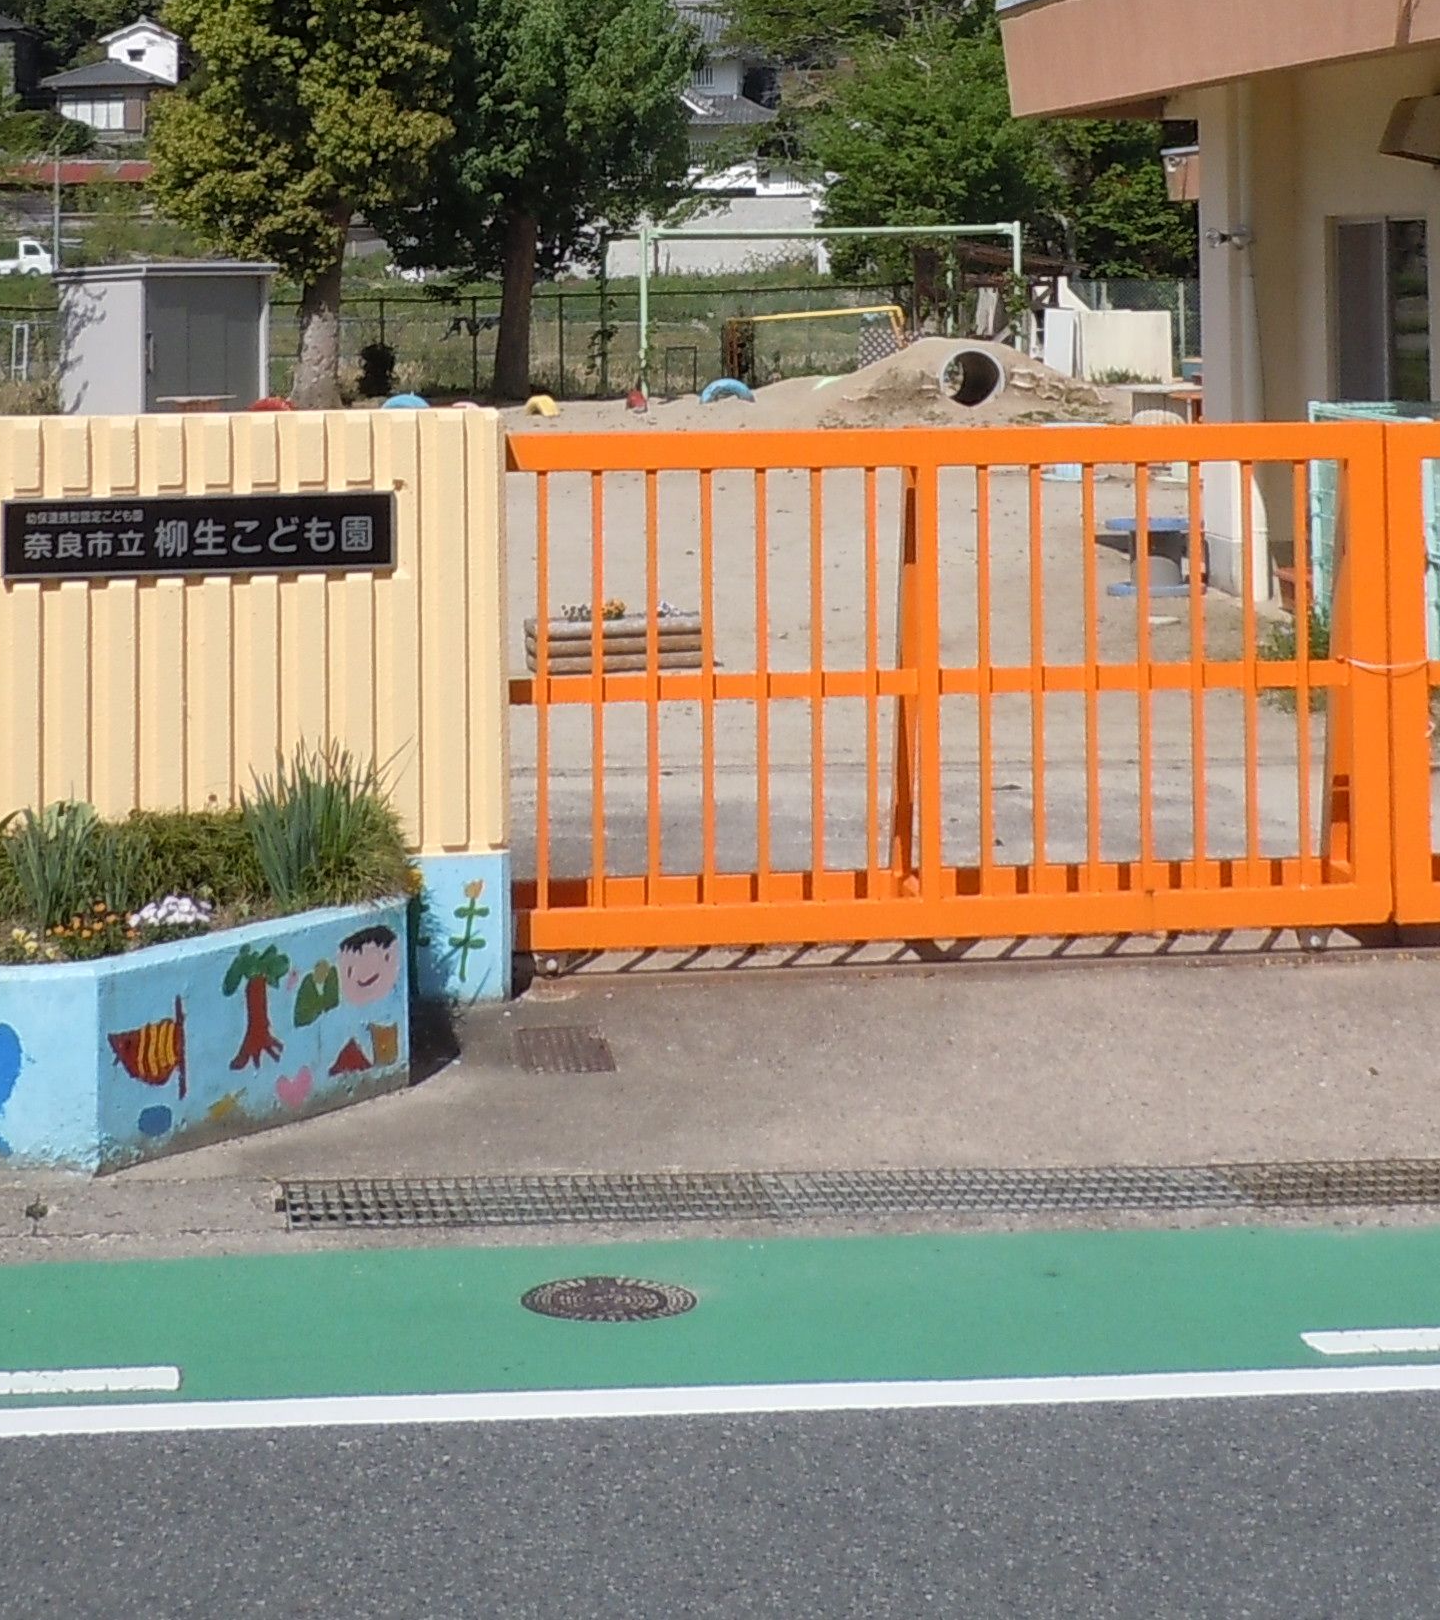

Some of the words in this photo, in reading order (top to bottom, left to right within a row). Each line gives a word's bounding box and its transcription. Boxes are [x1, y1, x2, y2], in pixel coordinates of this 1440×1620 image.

[23, 530, 146, 560] 奈良市立
[153, 515, 374, 558] 柳生こども園
